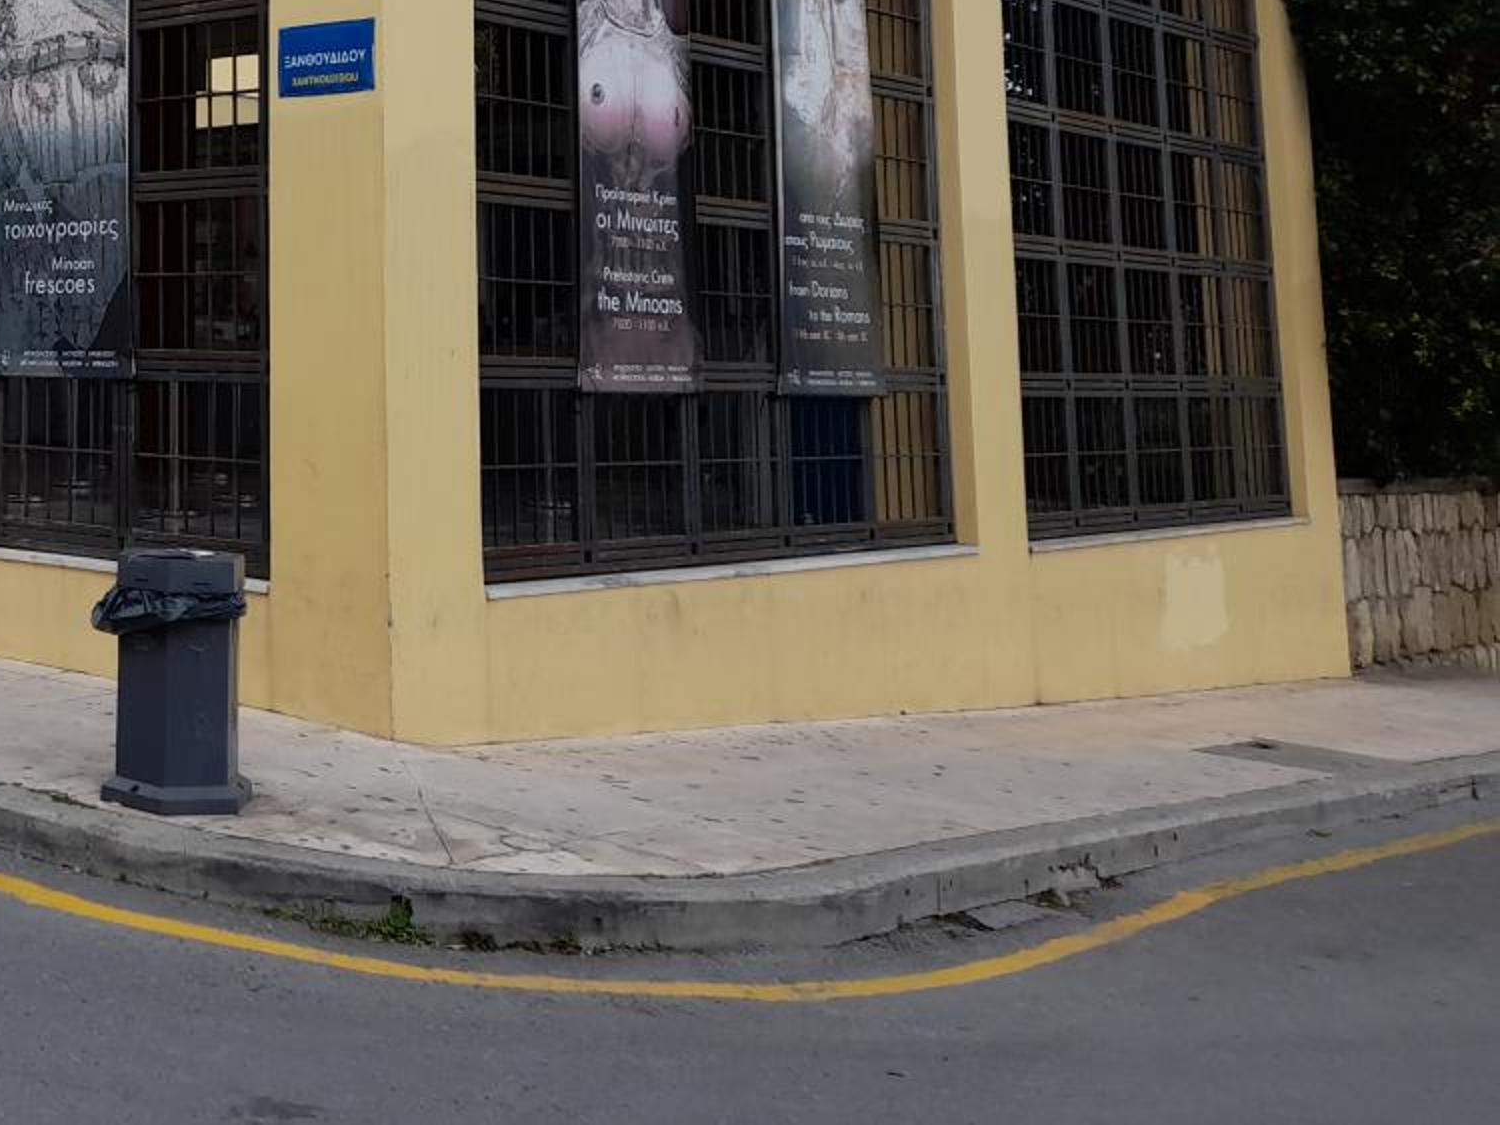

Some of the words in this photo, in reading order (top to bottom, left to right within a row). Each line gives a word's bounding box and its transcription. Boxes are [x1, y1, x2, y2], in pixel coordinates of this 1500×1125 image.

[283, 48, 367, 69] ΞΑΝΘΟΥΔΙΔΟΥ
[3, 213, 120, 243] τοιχογραφίες
[595, 213, 611, 229] οι
[51, 256, 95, 271] Minoan
[24, 270, 96, 294] frescoes
[811, 280, 848, 299] Dorians
[597, 285, 621, 311] the
[626, 290, 683, 314] Minoans
[834, 305, 871, 323] Romans
